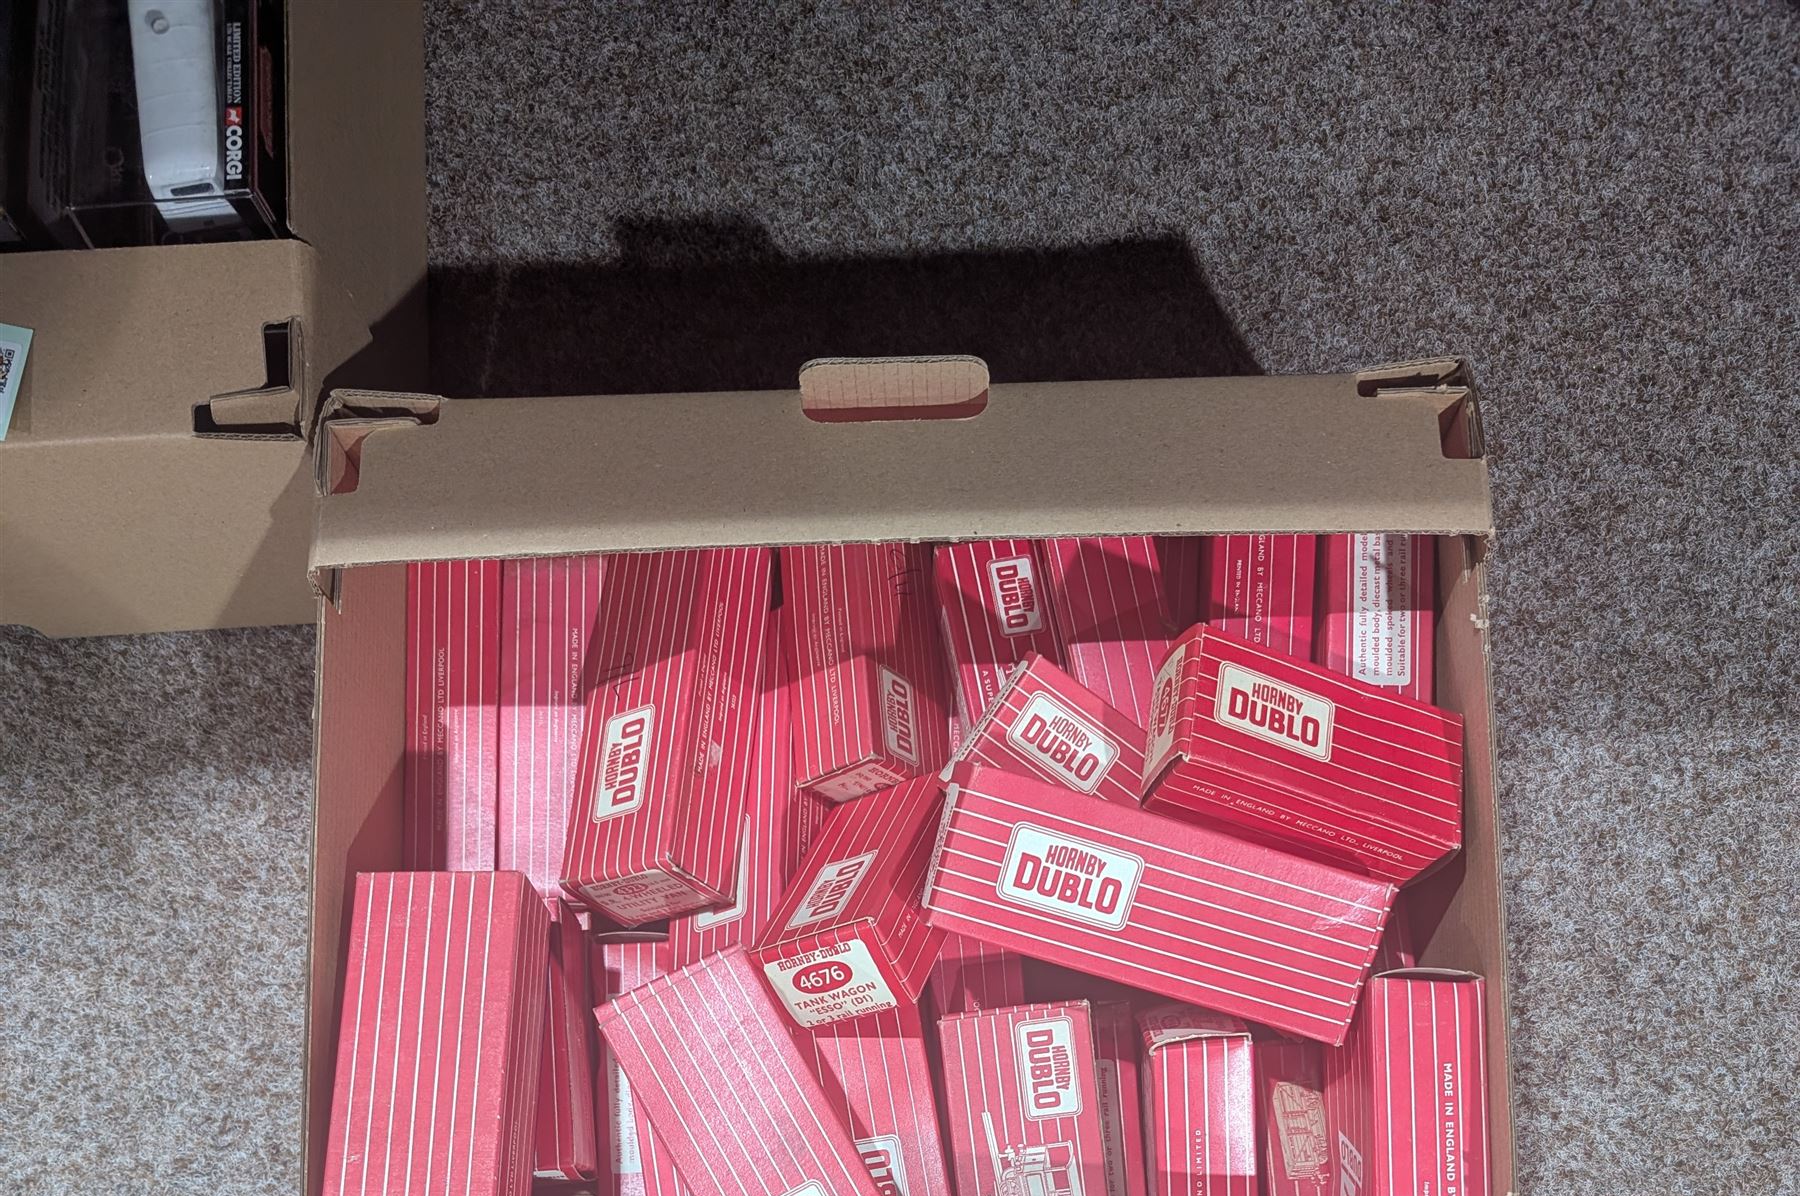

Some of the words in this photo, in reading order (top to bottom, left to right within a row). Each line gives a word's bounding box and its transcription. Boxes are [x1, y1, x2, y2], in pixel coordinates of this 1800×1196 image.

[233, 22, 241, 62] LIMITED
[233, 64, 242, 104] EDITION
[226, 125, 242, 180] CORGI
[1258, 535, 1266, 561] GLAND
[1398, 546, 1406, 564] rail
[1257, 567, 1264, 576] BY
[1360, 566, 1368, 602] detailed
[1385, 562, 1393, 593] wheels
[1398, 566, 1406, 591] three
[996, 565, 1029, 628] DUBLO
[1018, 577, 1035, 612] HORNBY
[1255, 582, 1263, 622] MECCANO
[1400, 593, 1406, 603] or
[1359, 606, 1369, 626] fully
[1385, 600, 1395, 630] spoked
[1398, 624, 1406, 635] for
[1359, 631, 1368, 675] Authentic
[1385, 637, 1393, 675] moulded
[887, 689, 898, 732] HORNBY
[1251, 682, 1303, 715] HORNBY
[892, 679, 912, 755] DUBLO
[1049, 715, 1093, 752] HORNBY
[1228, 687, 1320, 748] DUBLO
[611, 717, 645, 807] DUBLO
[1019, 713, 1099, 781] DUBLO
[605, 742, 622, 790] HORNBY
[1193, 784, 1216, 796] MADE
[1236, 799, 1275, 816] ENGLAND
[1296, 820, 1336, 837] MECCANO
[1362, 842, 1403, 861] LIVERPOOL
[1046, 845, 1107, 880] HORNBY
[806, 879, 835, 909] HORNBY
[809, 860, 863, 918] DUBLO
[1013, 852, 1122, 915] DUBLO
[777, 942, 851, 972] HORNBY-DUBLO
[800, 966, 845, 989] 4676
[794, 996, 828, 1011] TANK
[829, 981, 877, 1000] WAGON
[837, 1010, 852, 1019] rail
[855, 1001, 892, 1016] running
[851, 994, 874, 1007] (D1)
[1026, 1028, 1061, 1110] DUBLO
[1052, 1045, 1072, 1090] HORNBY
[1444, 1063, 1453, 1096] MADE
[1445, 1102, 1454, 1115] IN
[1445, 1122, 1456, 1181] ENGLAND
